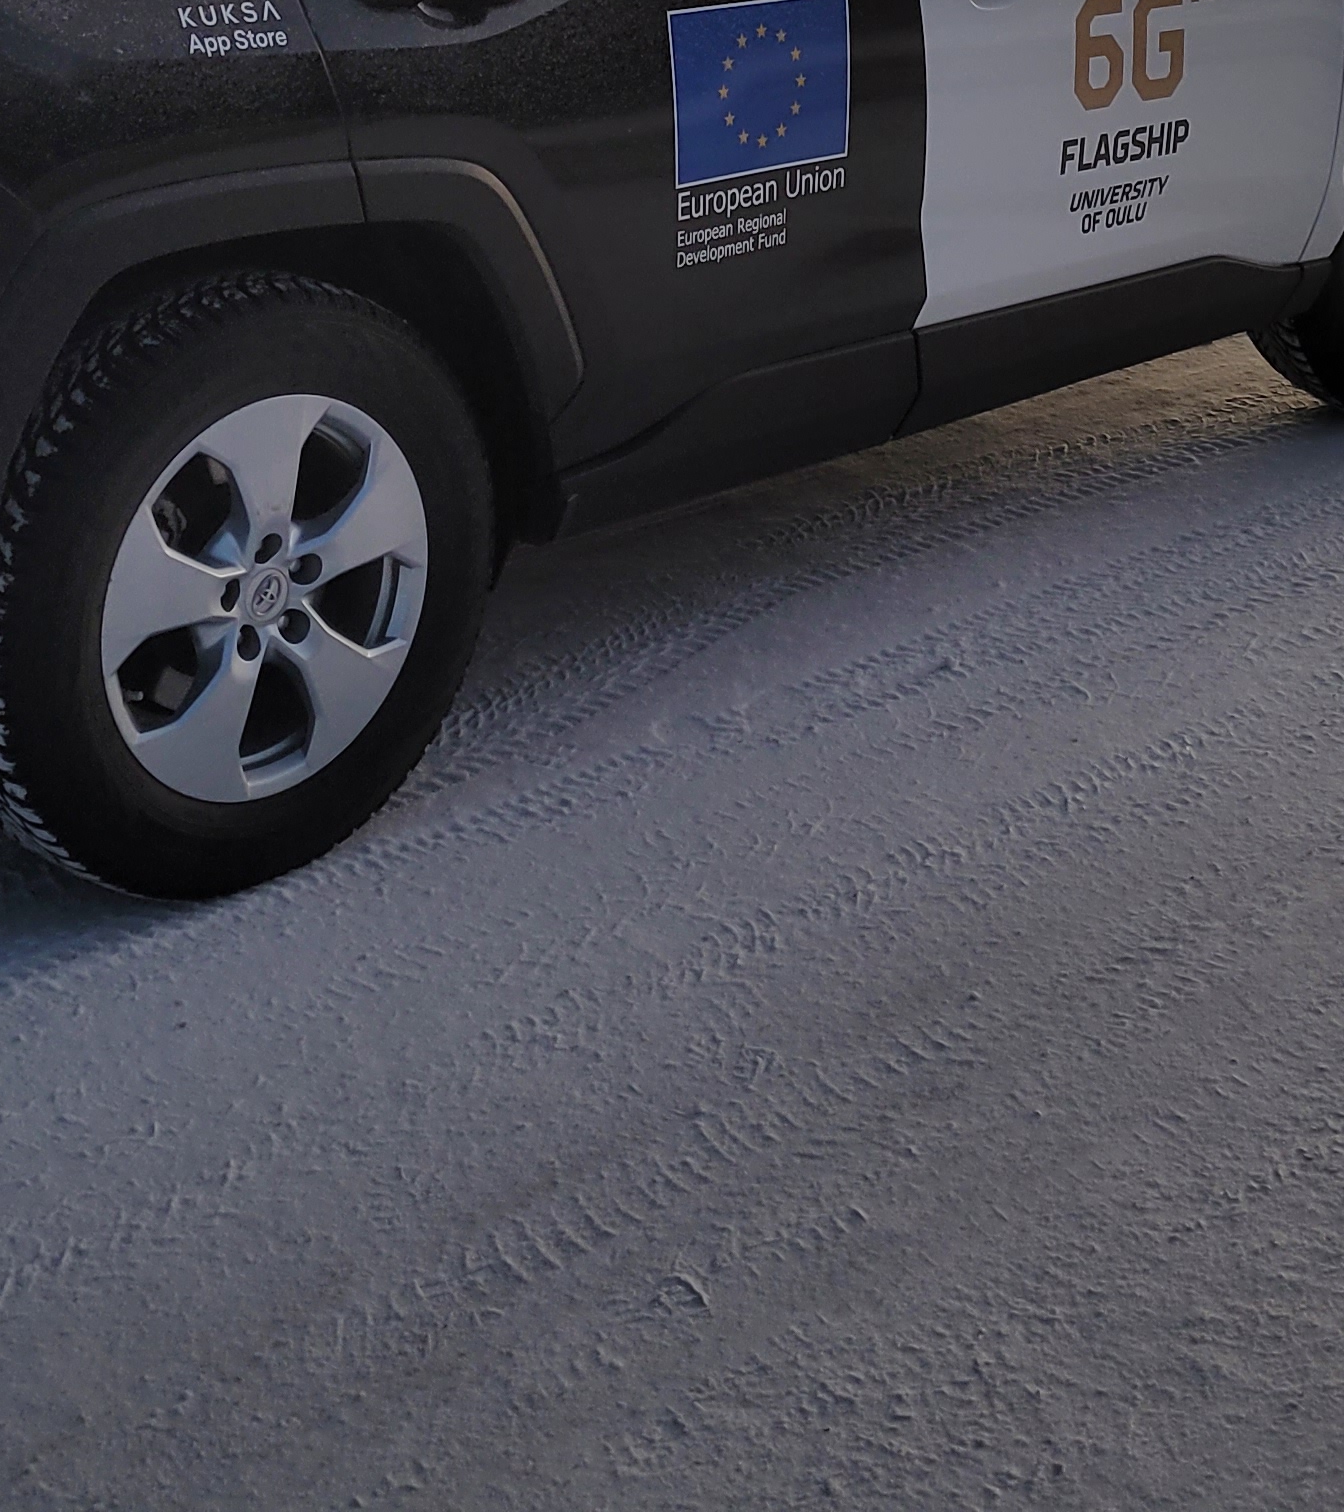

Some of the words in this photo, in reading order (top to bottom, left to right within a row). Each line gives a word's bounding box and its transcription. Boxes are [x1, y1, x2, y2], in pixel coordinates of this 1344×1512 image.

[177, 0, 282, 28] KUKSA
[189, 33, 231, 57] App
[233, 29, 288, 51] Store
[1060, 119, 1190, 176] FLAGSHIP
[677, 179, 778, 222] European
[785, 165, 846, 199] Union
[1069, 174, 1170, 213] UNIVERSITY
[677, 223, 734, 248] European
[737, 207, 787, 234] Regional
[1081, 211, 1103, 234] OF
[1105, 201, 1148, 229] OULU
[676, 236, 755, 269] Development
[757, 227, 787, 250] Fund
